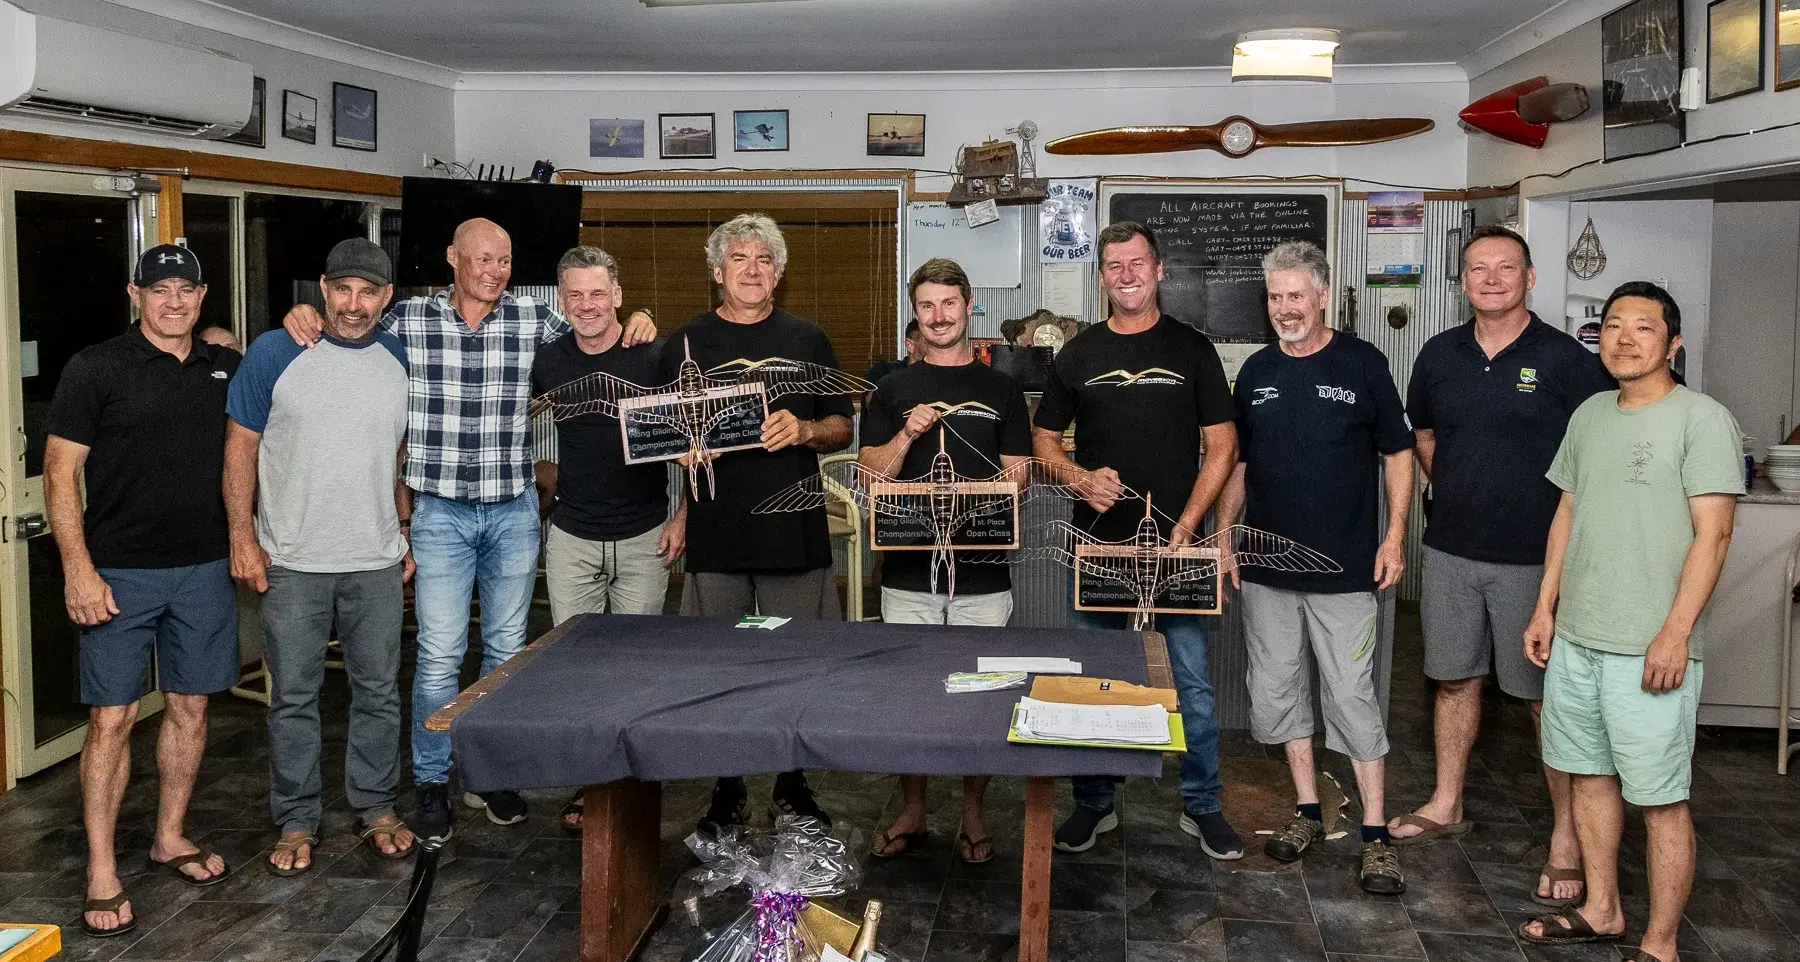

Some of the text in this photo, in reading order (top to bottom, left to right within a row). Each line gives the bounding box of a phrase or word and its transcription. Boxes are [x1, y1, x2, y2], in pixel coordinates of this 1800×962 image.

[1067, 184, 1094, 201] TEAM
[1160, 201, 1298, 213] ALL AIRCRAFT BOOKINGS
[1147, 208, 1309, 225] ARE NOW MADE VIA THE ONLINE
[914, 219, 946, 229] Thursday
[1168, 239, 1194, 247] CALL
[1042, 243, 1091, 260] OUR BEER
[743, 418, 761, 427] Place
[720, 430, 741, 442] Open
[631, 438, 687, 453] Championship
[878, 518, 898, 526] Hang
[988, 518, 1006, 526] Place
[878, 531, 932, 539] Championship
[966, 529, 987, 538] Open
[989, 529, 1011, 537] Class
[1082, 579, 1102, 587] Hang
[1082, 591, 1135, 600] Championship
[1169, 594, 1190, 602] Open
[1192, 594, 1214, 602] Class
